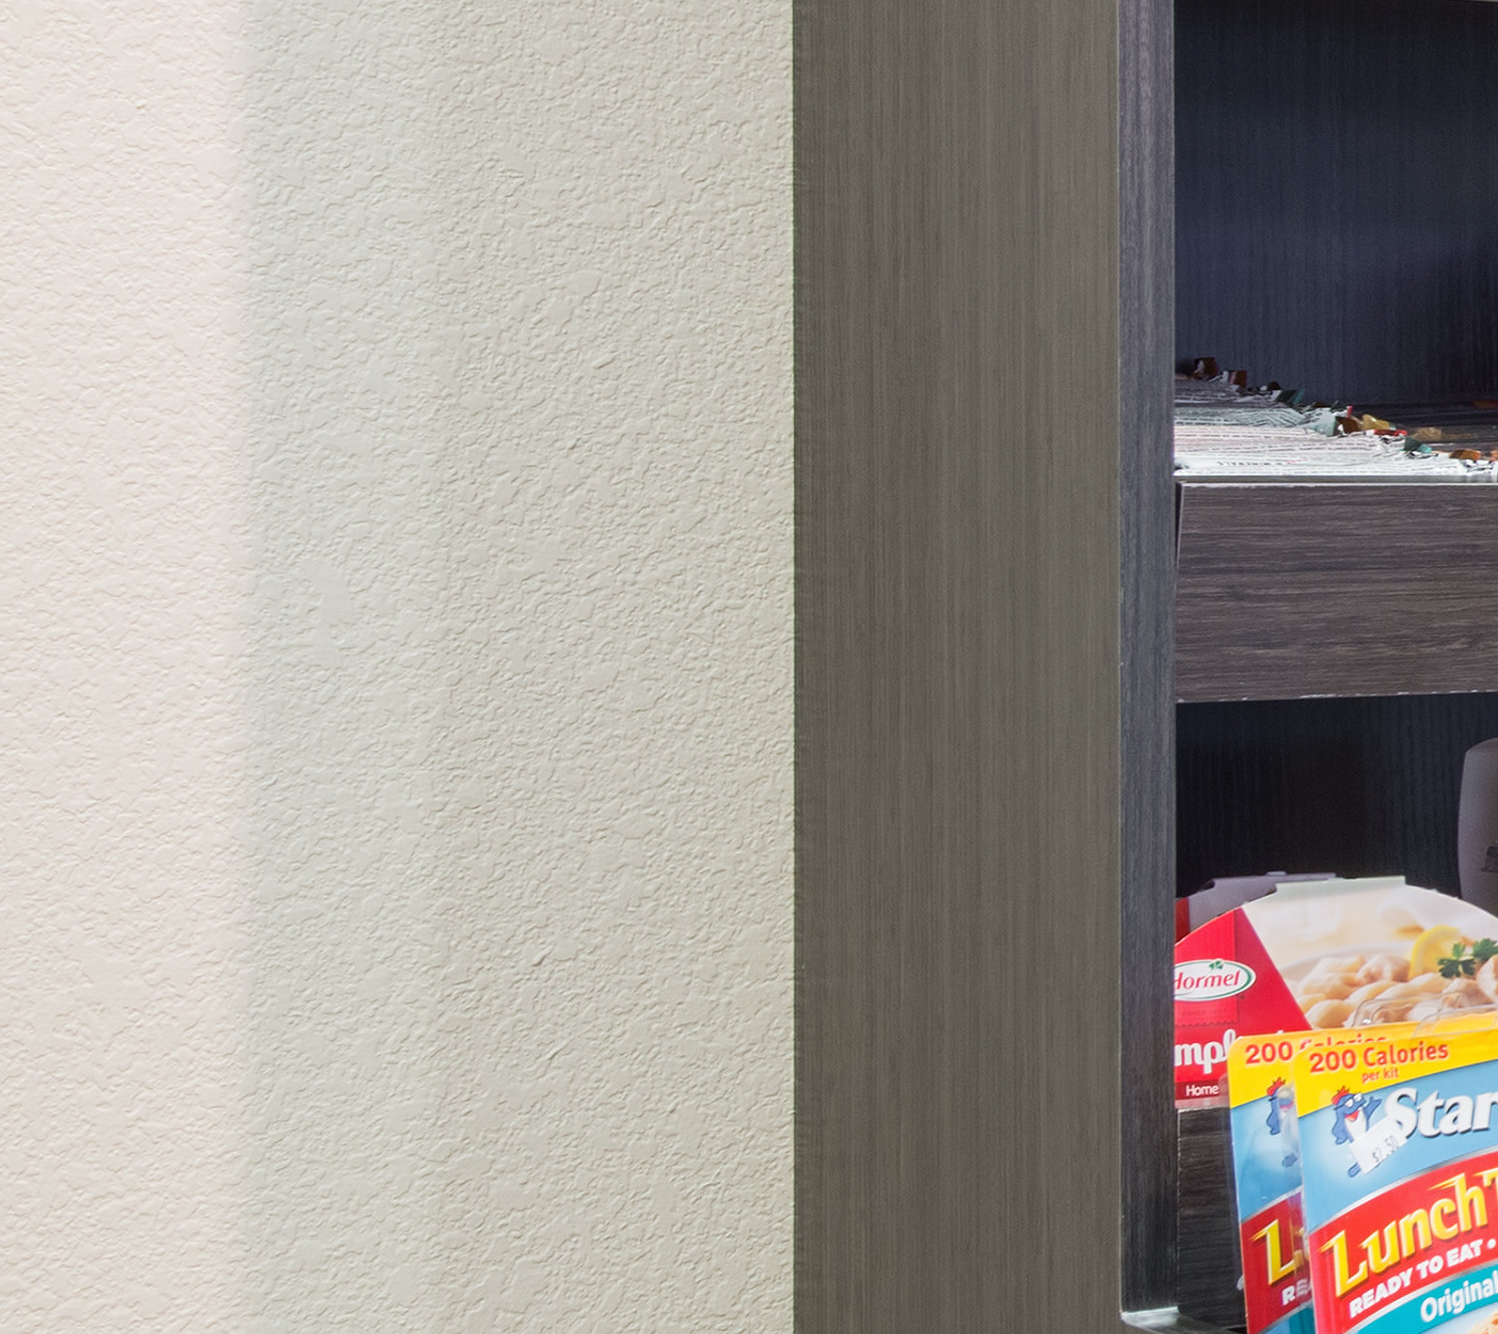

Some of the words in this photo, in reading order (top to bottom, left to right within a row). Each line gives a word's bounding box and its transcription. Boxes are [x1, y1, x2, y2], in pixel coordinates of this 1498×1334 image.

[1245, 1041, 1292, 1065] 200
[1309, 1051, 1357, 1073] 200
[1362, 1041, 1449, 1068] Calories
[1361, 1071, 1381, 1085] per
[1382, 1067, 1399, 1081] kit
[1322, 1173, 1477, 1298] Lunch
[1349, 1277, 1413, 1319] READY
[1447, 1241, 1483, 1266] EAT
